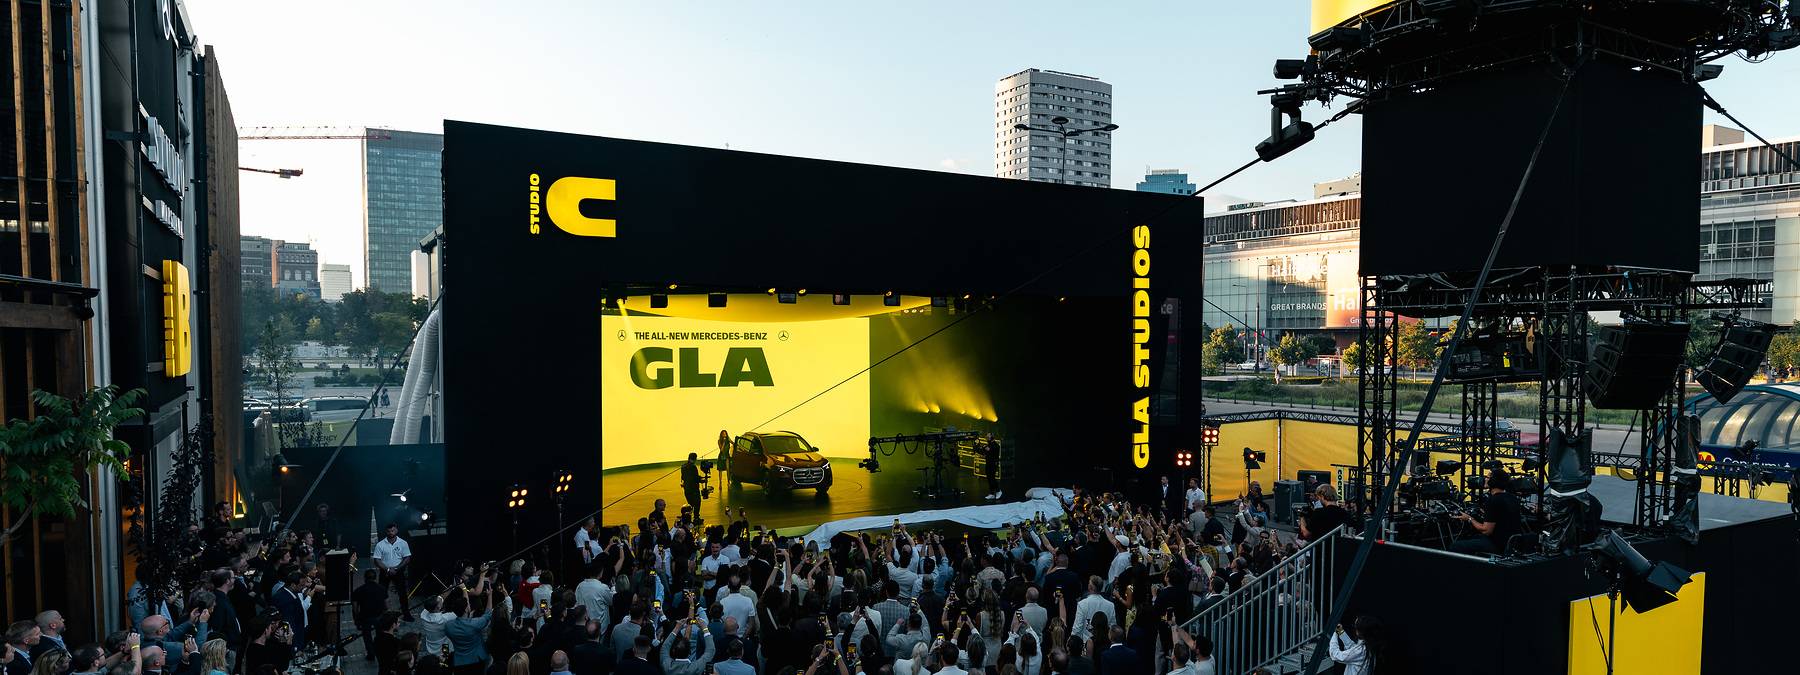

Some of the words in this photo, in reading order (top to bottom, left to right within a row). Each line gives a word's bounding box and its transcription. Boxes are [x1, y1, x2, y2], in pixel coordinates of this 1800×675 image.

[529, 173, 540, 235] STUDIO
[546, 176, 617, 238] C
[163, 259, 192, 379] B
[633, 331, 650, 341] THE
[651, 331, 690, 341] ALL-NEW
[690, 331, 768, 341] MERCEDES-BENZ
[1132, 225, 1150, 389] STUDIOS
[1271, 303, 1296, 312] GREAT
[1296, 302, 1327, 312] BRANDS
[629, 347, 775, 390] GLA
[1132, 395, 1150, 469] GLA
